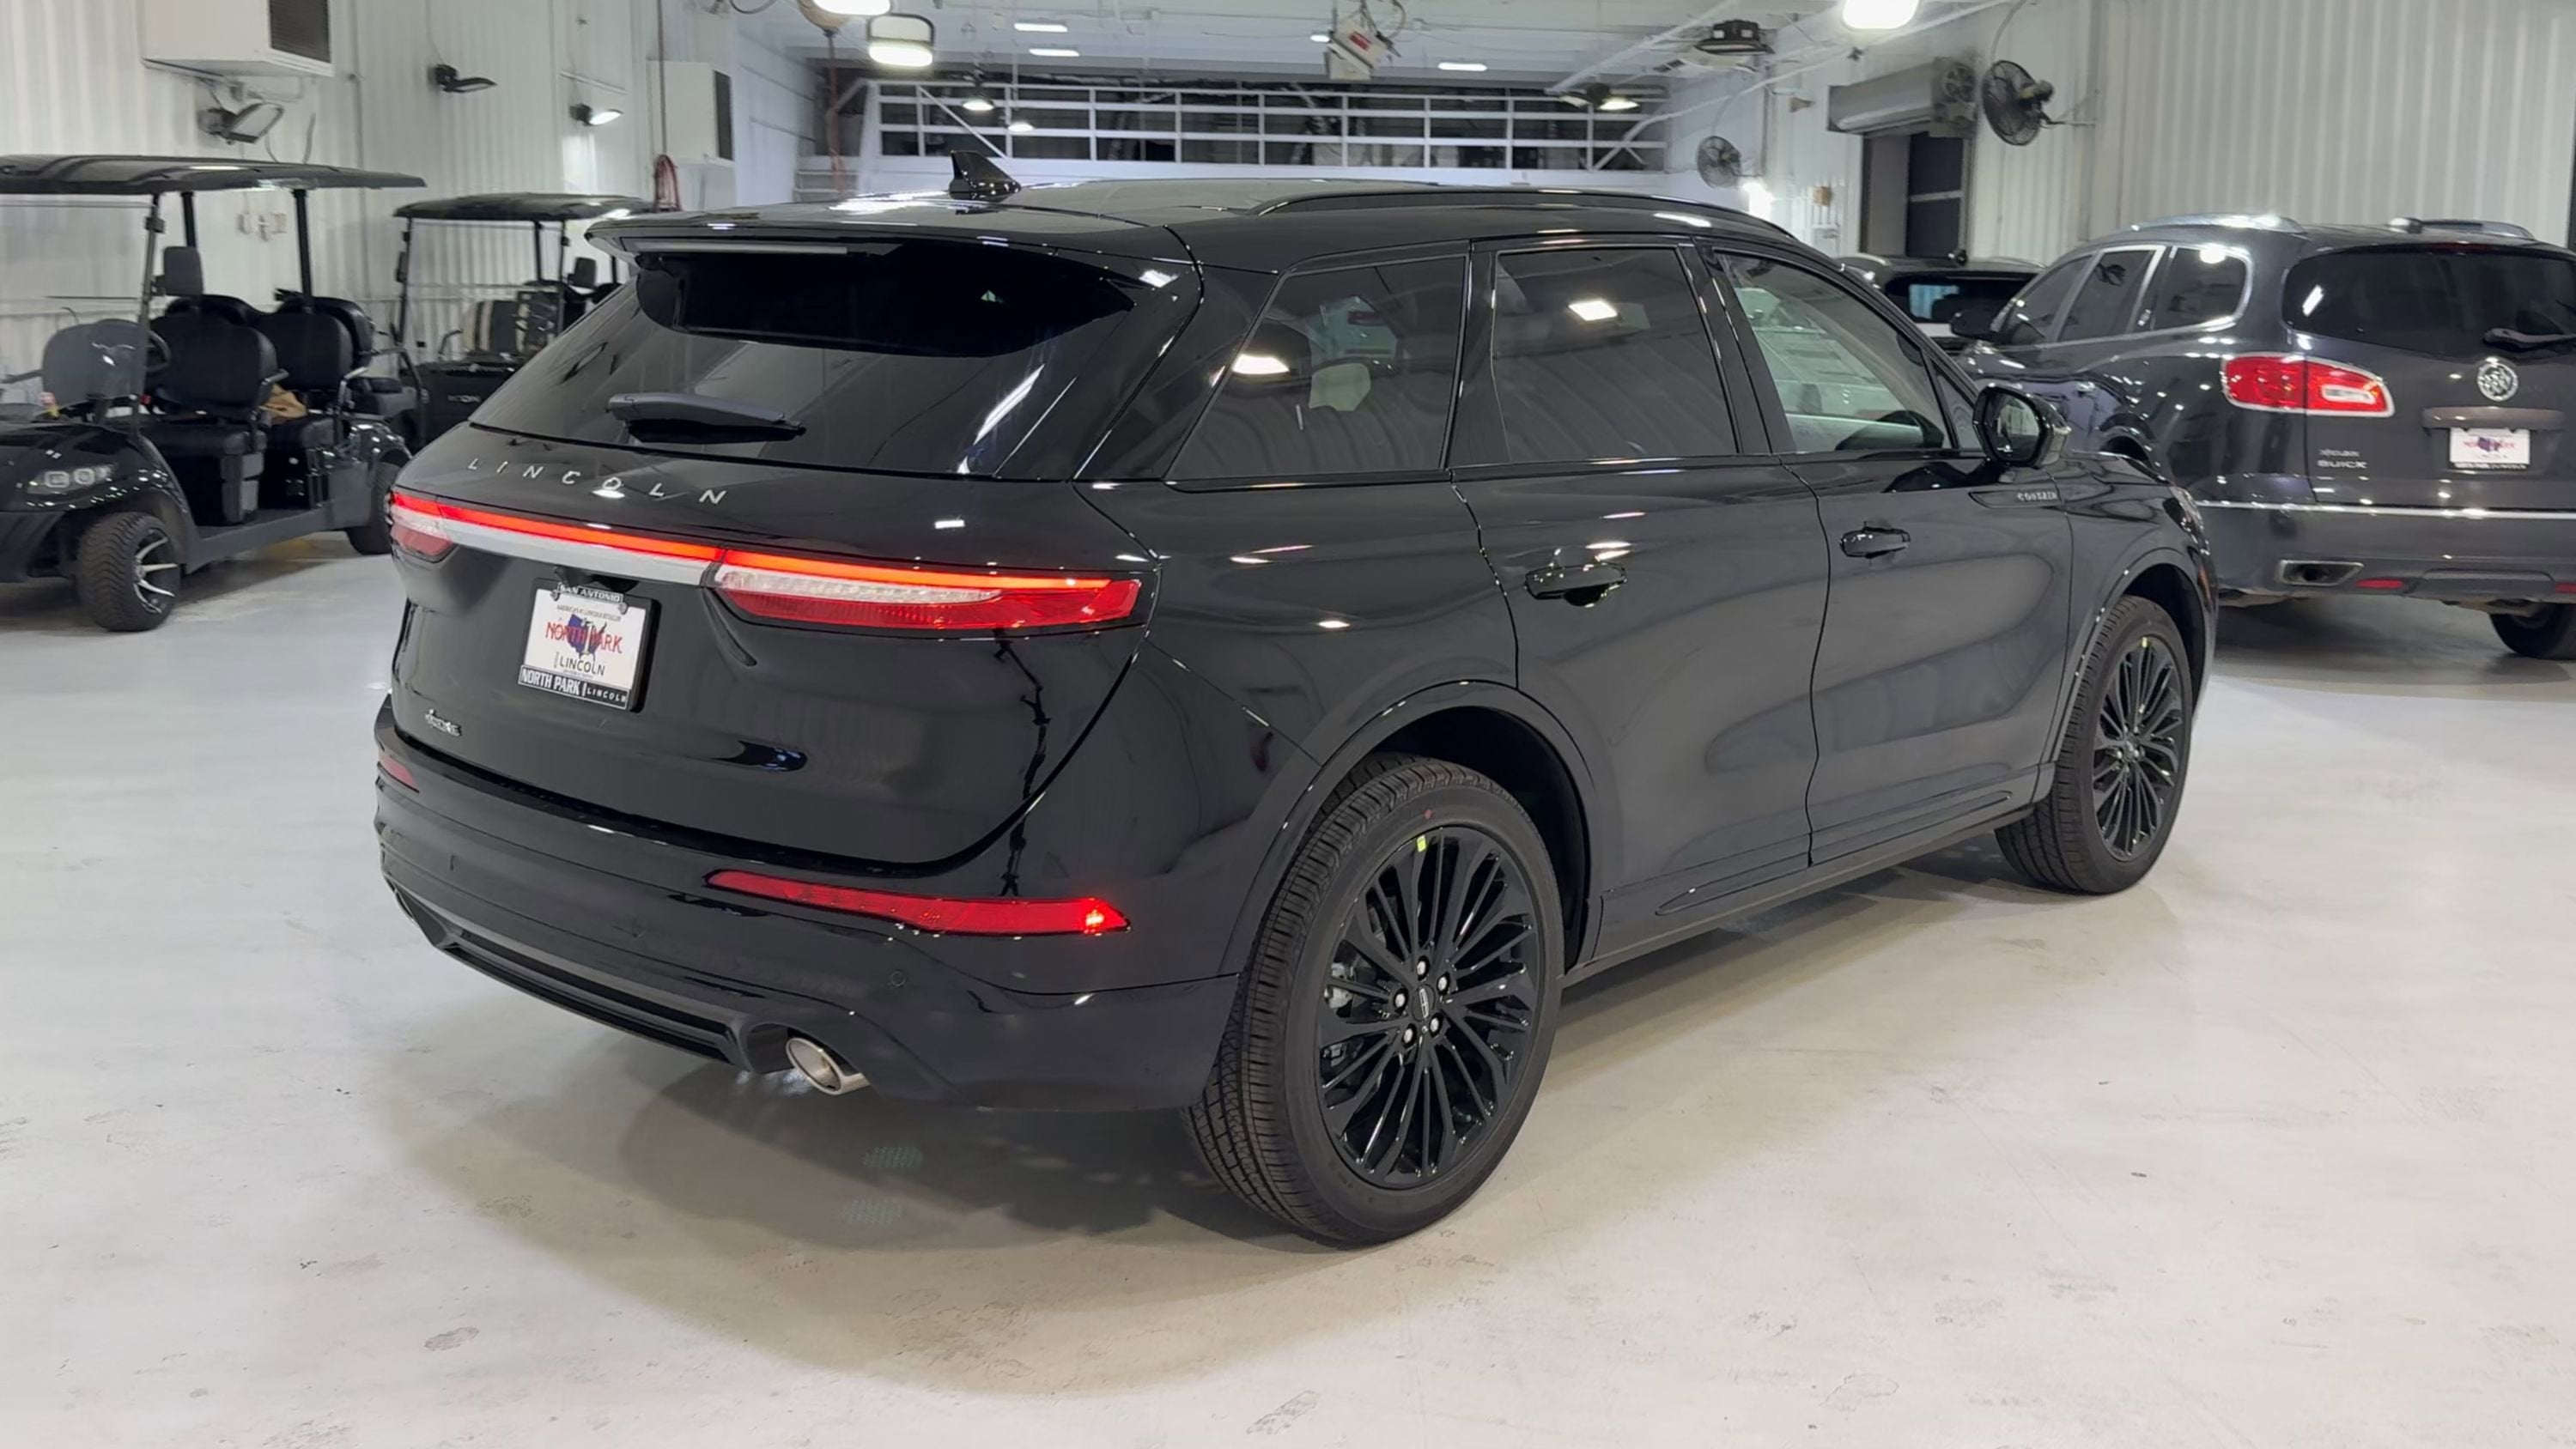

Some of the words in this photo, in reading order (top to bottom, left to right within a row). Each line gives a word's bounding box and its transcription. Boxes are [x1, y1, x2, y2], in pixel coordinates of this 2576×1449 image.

[467, 458, 727, 505] LINCOLN
[559, 584, 580, 594] SAN
[580, 589, 621, 602] ANTONIO
[545, 621, 588, 646] NORTH
[560, 656, 605, 676] LINCOLN
[520, 668, 553, 688] NORTH
[553, 676, 581, 696] PARK
[587, 687, 627, 703] LINCOLN
